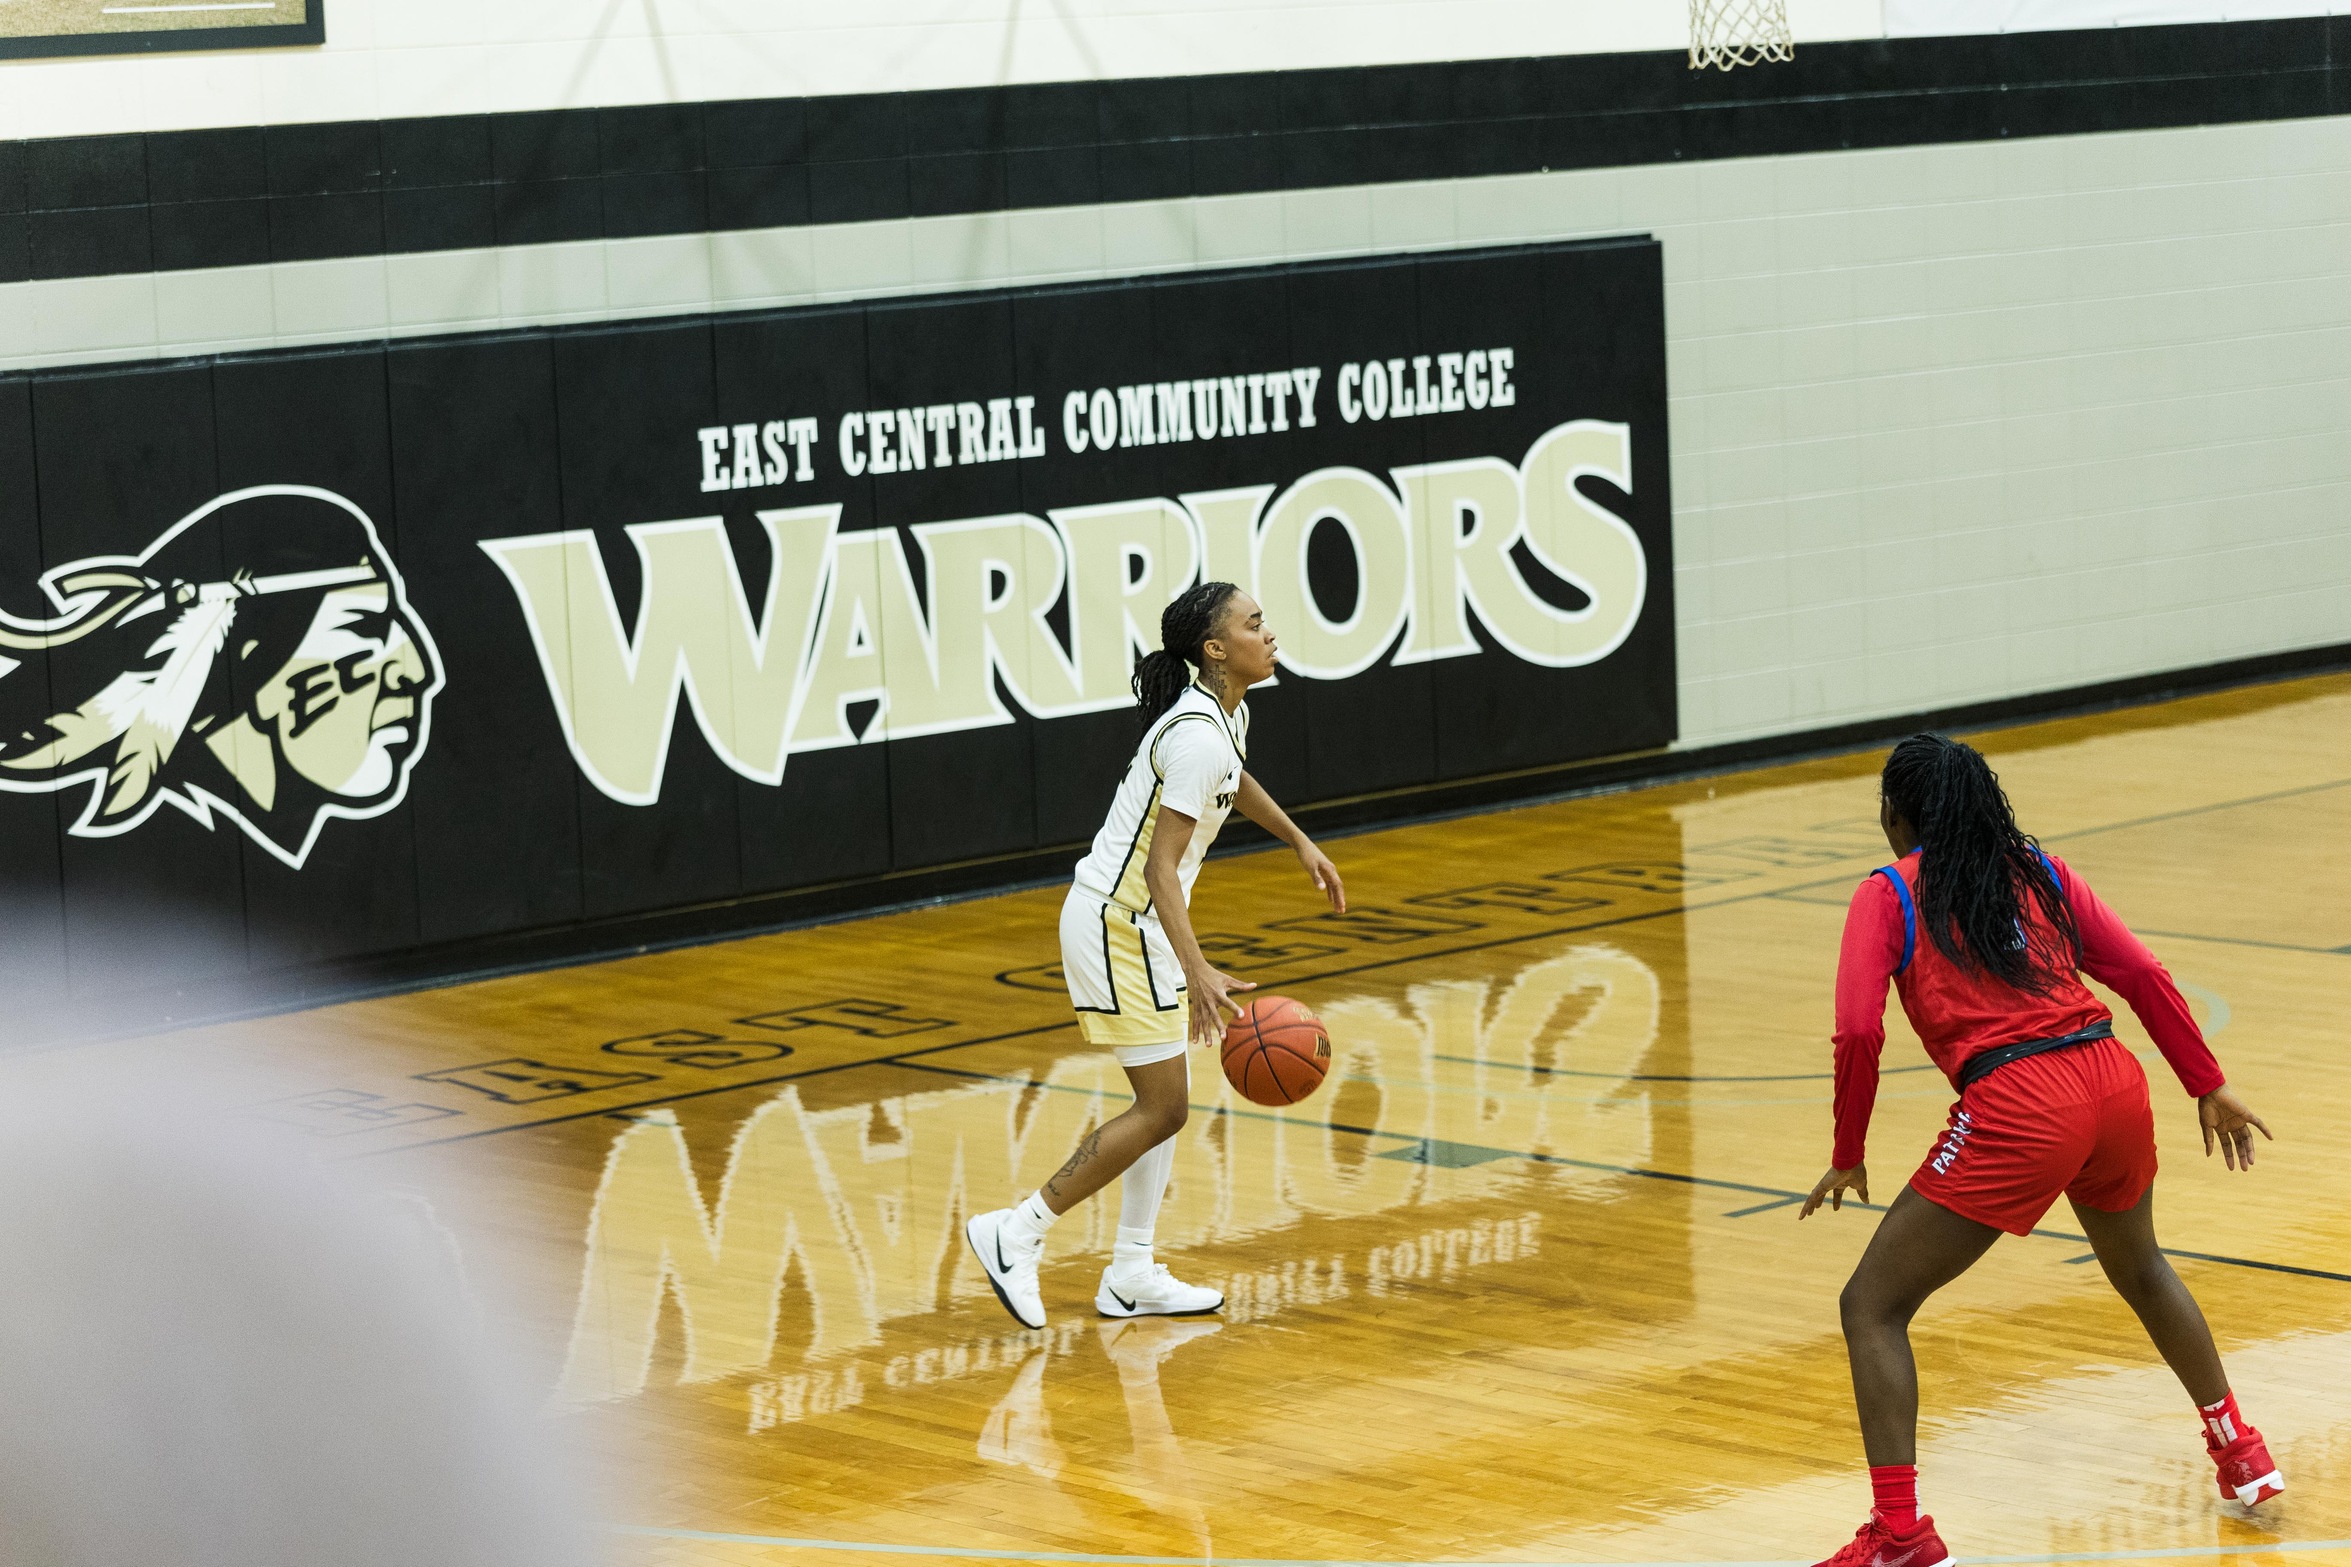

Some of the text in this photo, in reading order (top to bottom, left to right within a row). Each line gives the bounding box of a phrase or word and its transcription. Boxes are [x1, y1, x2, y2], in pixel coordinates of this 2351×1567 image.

[698, 347, 1516, 493] EAST CENTRAL COMMUNITY COLLEGE
[477, 418, 1648, 807] WARRIORS
